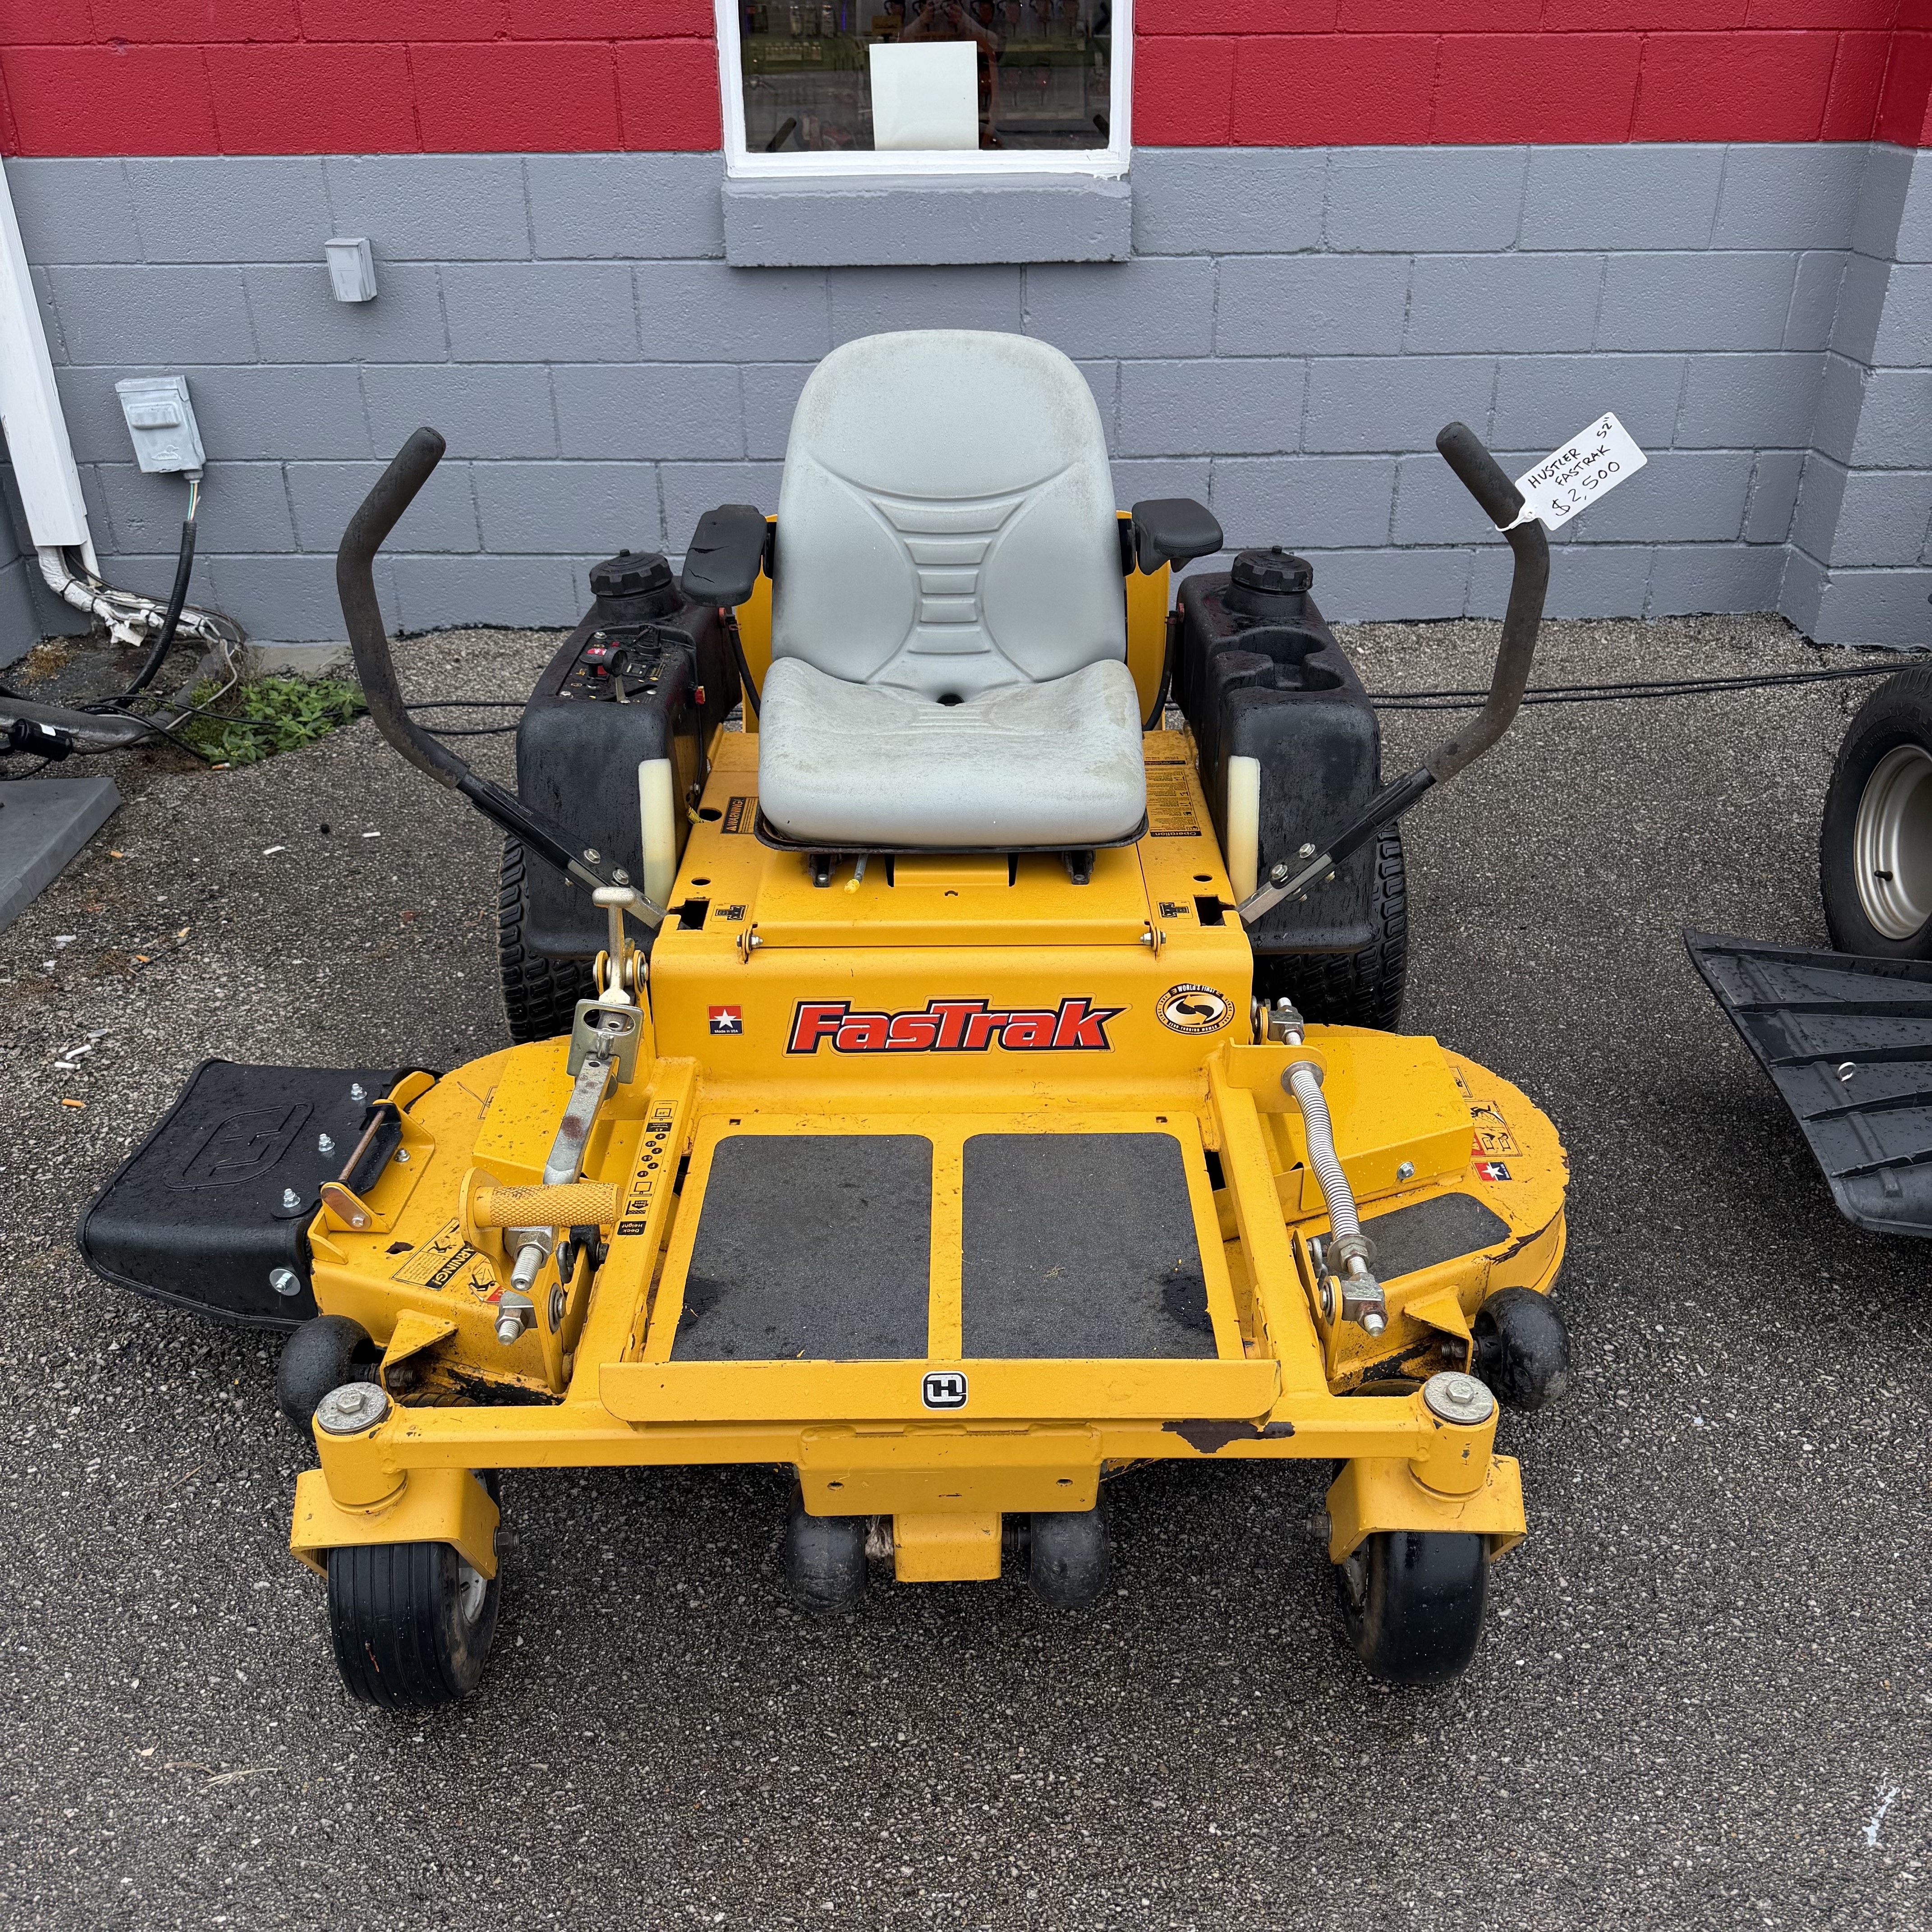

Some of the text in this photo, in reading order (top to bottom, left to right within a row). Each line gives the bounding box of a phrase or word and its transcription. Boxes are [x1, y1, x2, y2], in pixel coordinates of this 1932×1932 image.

[1528, 448, 1581, 488] HUSTLER
[1555, 445, 1610, 486] FASTRAK
[786, 998, 1127, 1054] FasTrak
[431, 1247, 475, 1285] ARNING!
